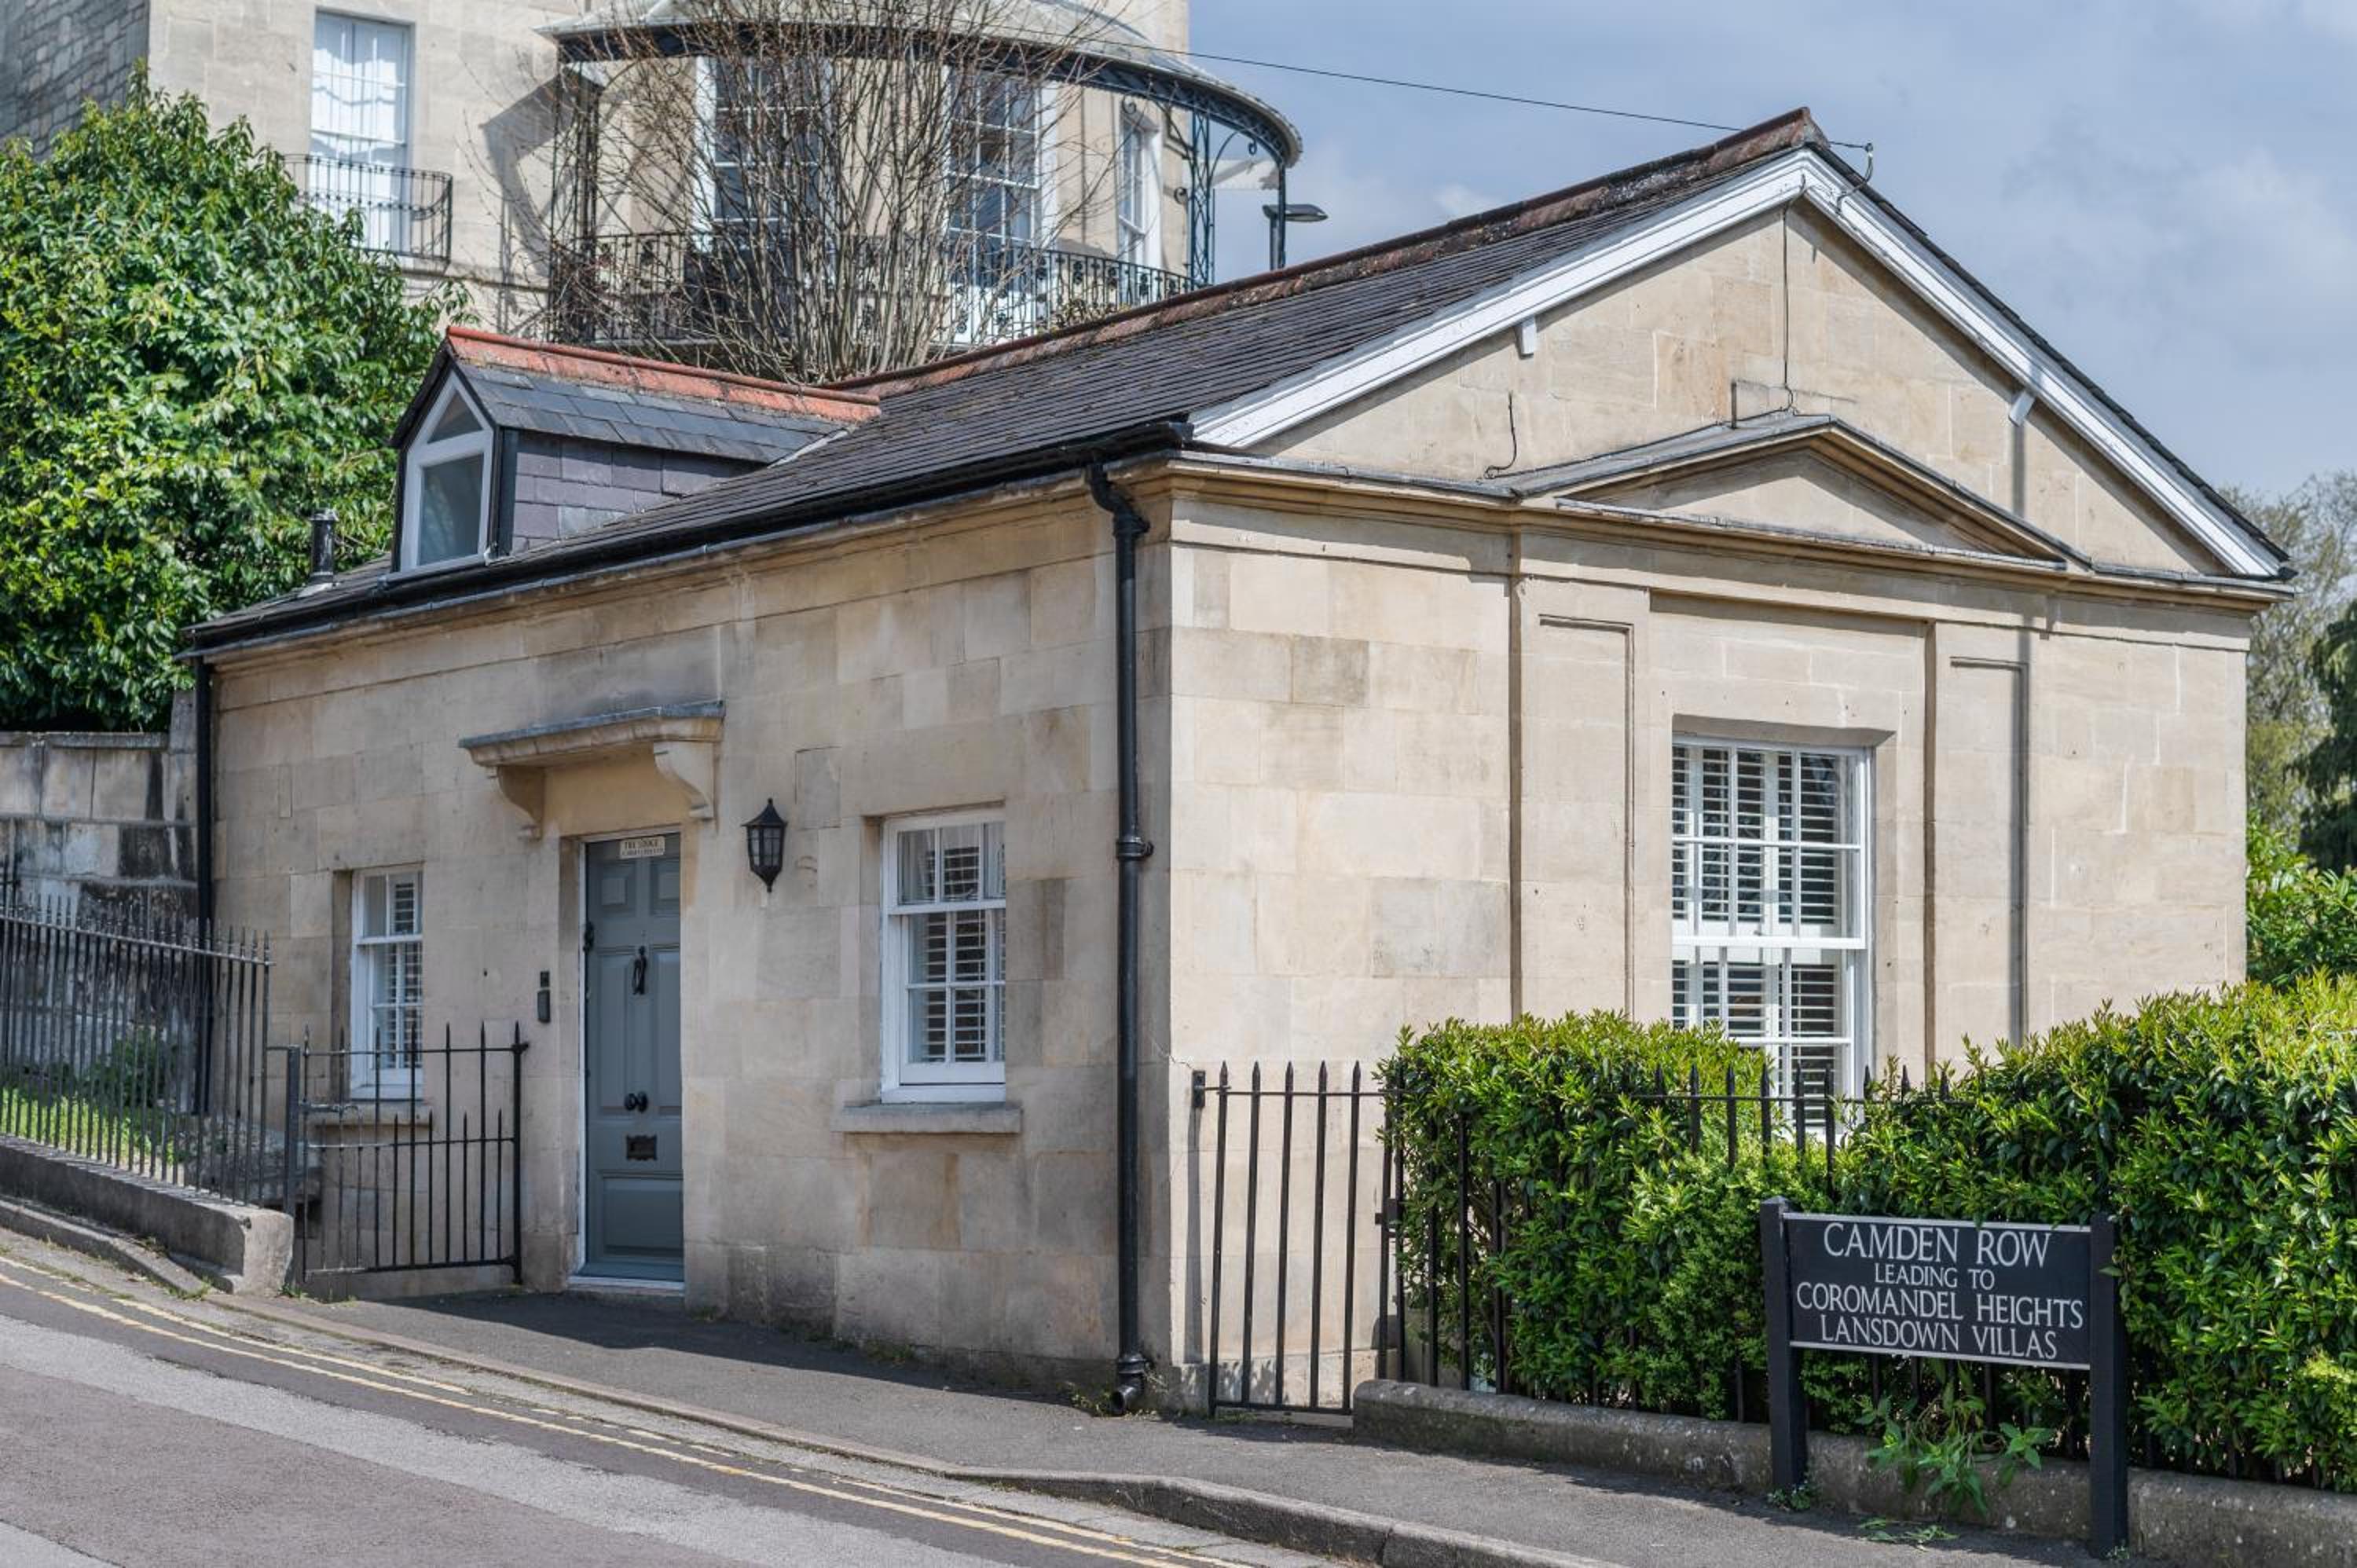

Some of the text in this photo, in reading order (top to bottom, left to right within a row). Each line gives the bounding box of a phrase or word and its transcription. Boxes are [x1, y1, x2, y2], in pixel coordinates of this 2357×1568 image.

[1824, 1222, 2051, 1267] CAMDEN ROW
[1875, 1263, 1995, 1290] LEADING TO
[1797, 1282, 2084, 1328] COROMANDEL HEIGHTS
[1820, 1314, 2058, 1360] LANSDOWN VILLAS
